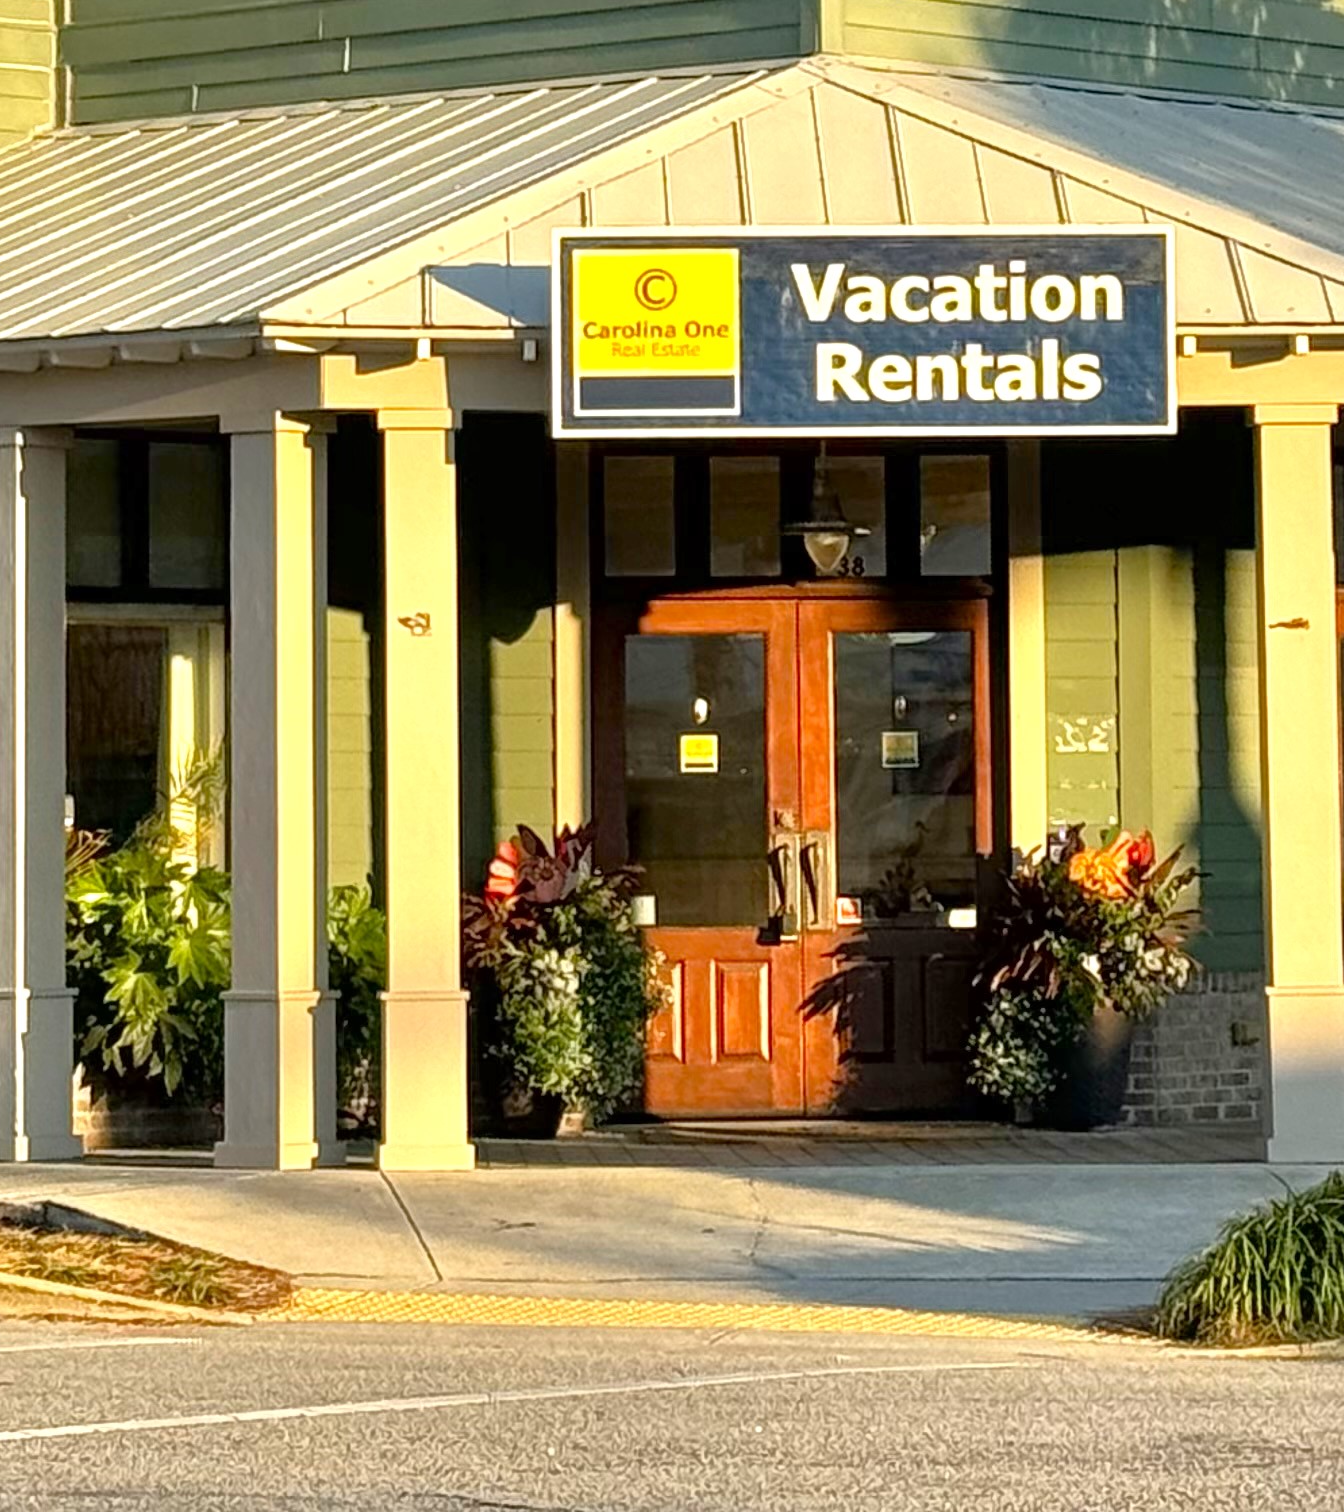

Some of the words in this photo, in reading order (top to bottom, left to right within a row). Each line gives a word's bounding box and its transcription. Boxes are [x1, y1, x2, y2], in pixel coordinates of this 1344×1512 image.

[790, 260, 1124, 324] Vacation
[583, 321, 677, 339] Carolina
[684, 320, 729, 338] One
[612, 341, 646, 357] Real
[651, 341, 701, 357] Estate
[815, 338, 1103, 402] Rentals
